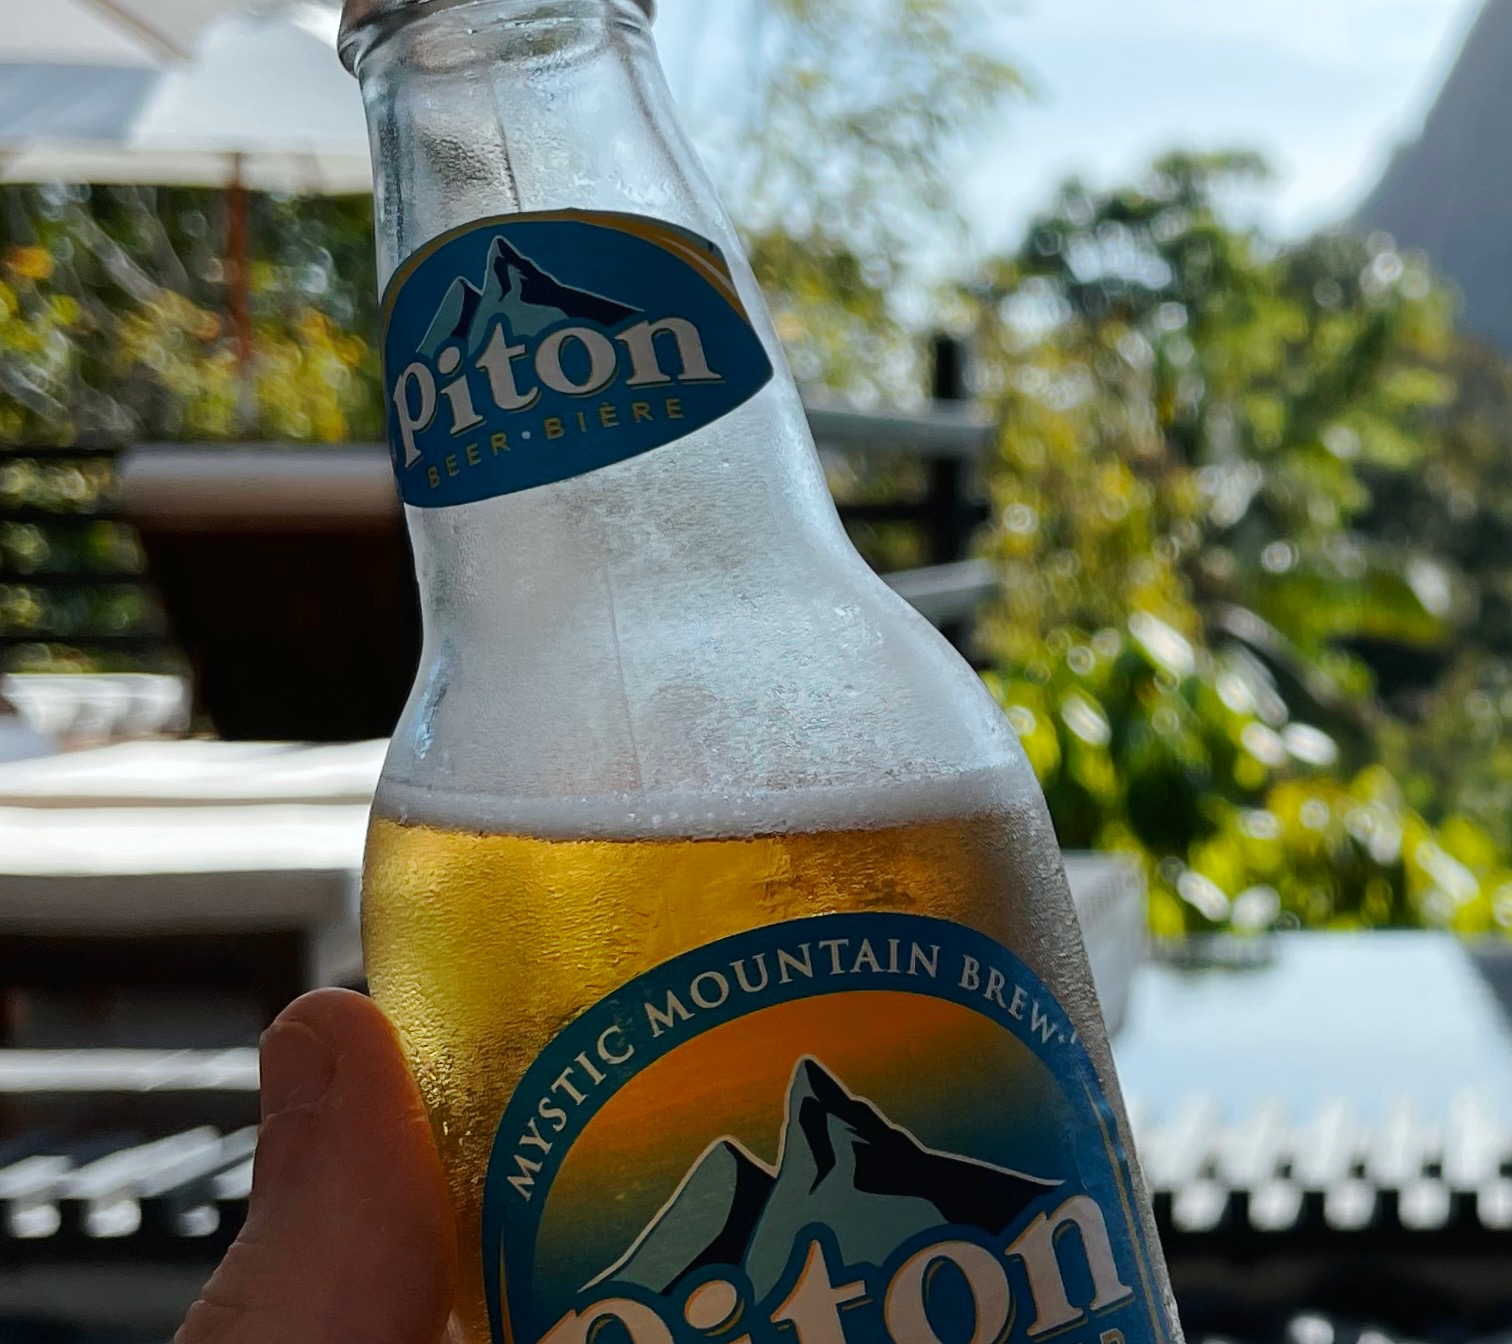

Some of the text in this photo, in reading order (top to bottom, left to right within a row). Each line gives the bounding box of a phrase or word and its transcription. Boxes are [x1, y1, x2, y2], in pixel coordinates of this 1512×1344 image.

[393, 317, 725, 470] piton
[507, 1025, 636, 1203] MYSTIC
[643, 937, 941, 1039] MOUNTAIN
